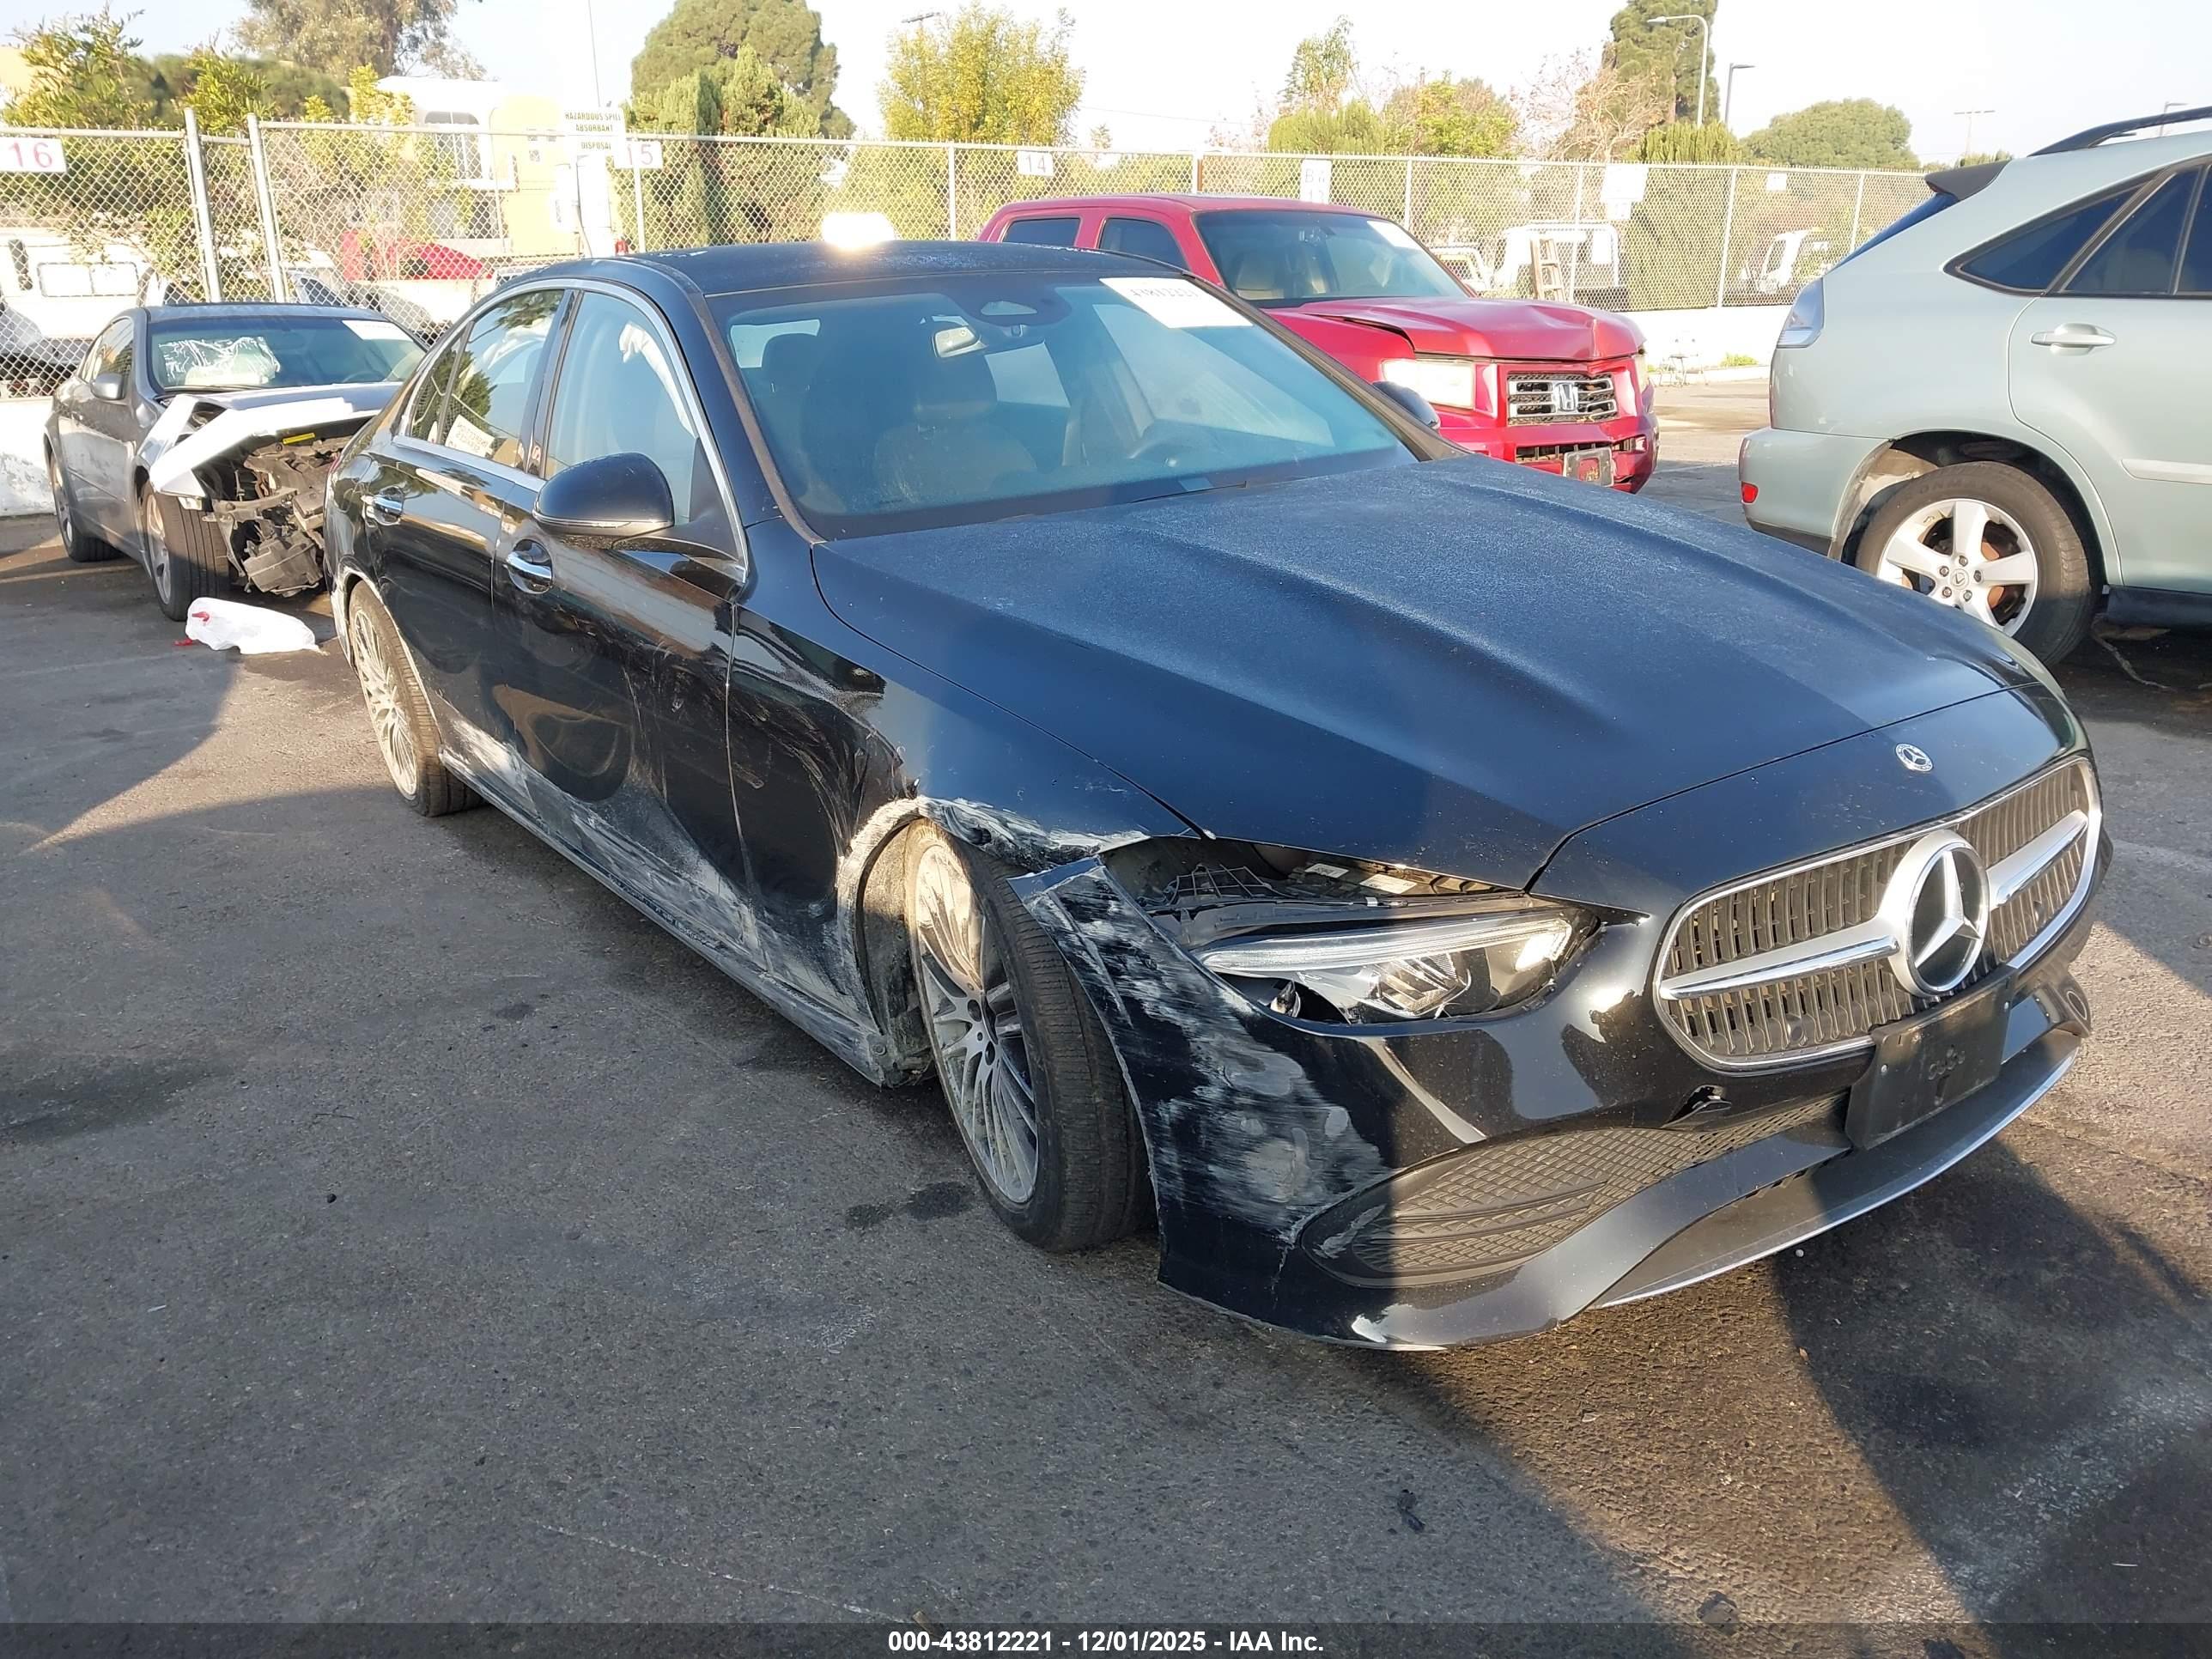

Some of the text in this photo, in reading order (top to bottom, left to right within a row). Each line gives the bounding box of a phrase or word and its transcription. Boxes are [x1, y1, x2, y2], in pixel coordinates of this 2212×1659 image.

[564, 112, 604, 121] HAZARDOUS
[8, 141, 53, 168] 16
[580, 141, 611, 150] DISPOSAL
[627, 143, 653, 166] 15
[1025, 154, 1047, 173] 14
